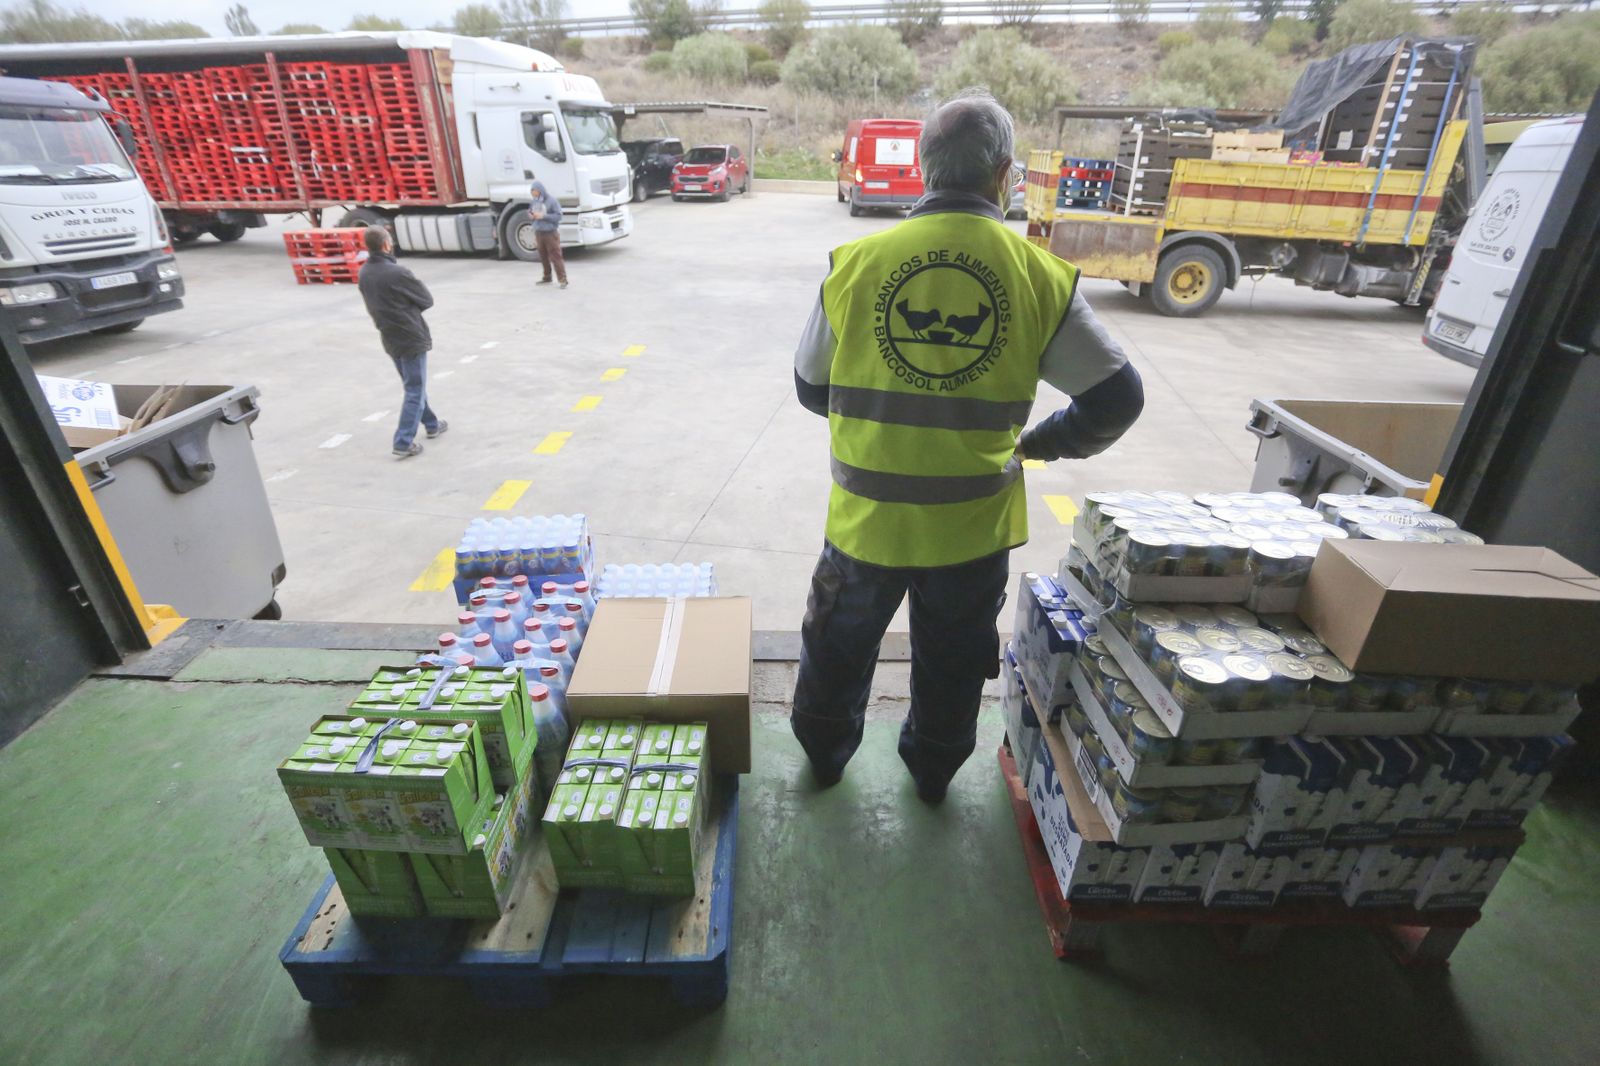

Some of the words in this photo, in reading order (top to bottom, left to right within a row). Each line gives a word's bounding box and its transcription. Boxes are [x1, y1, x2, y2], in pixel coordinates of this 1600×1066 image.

[61, 191, 97, 200] IVECO
[874, 256, 922, 314] BANCOS
[927, 250, 949, 263] DE
[954, 252, 1011, 323] ALIMENTOS
[874, 326, 935, 391] BANCOSOL
[939, 335, 1008, 392] ALIMENTOS
